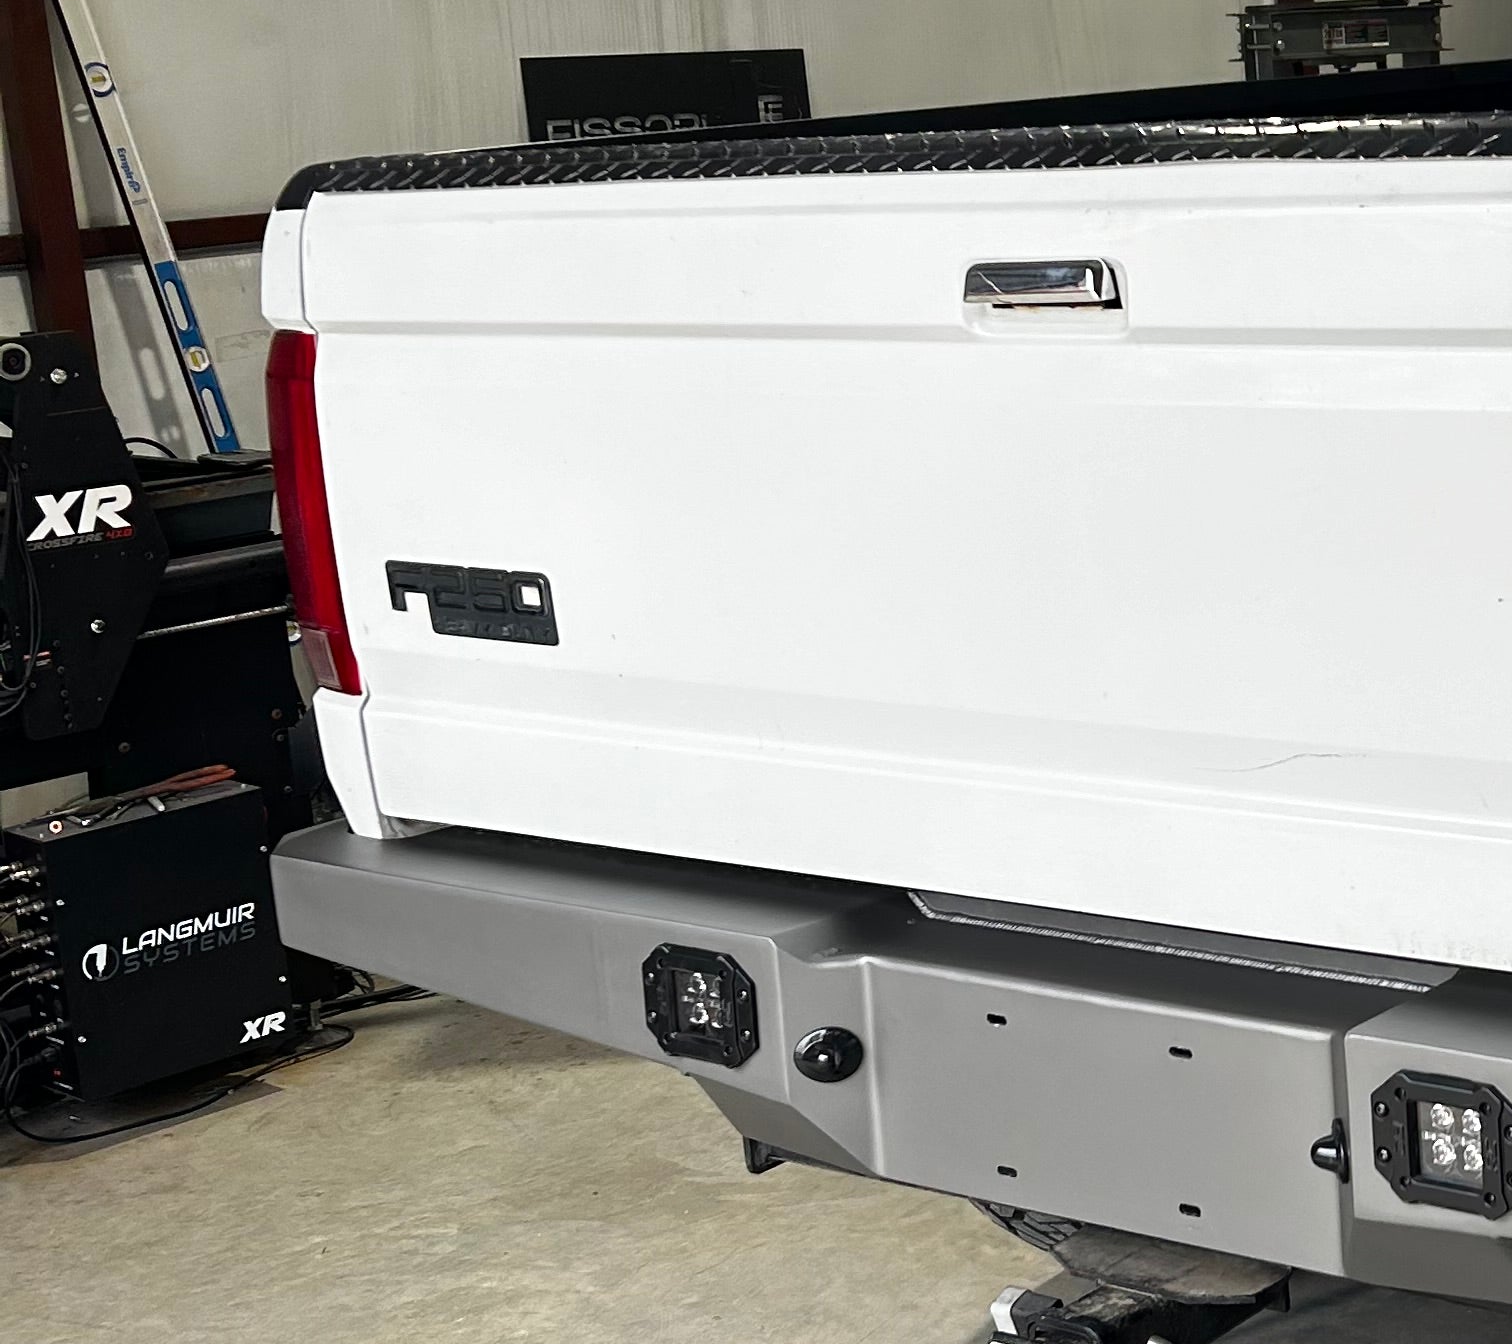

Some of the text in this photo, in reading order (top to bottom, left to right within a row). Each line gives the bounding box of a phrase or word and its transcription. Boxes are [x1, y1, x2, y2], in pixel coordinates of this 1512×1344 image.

[26, 484, 132, 542] XR
[121, 902, 255, 955] LANGMUIR
[123, 920, 256, 975] SYSTEMS
[239, 1011, 286, 1044] XR
